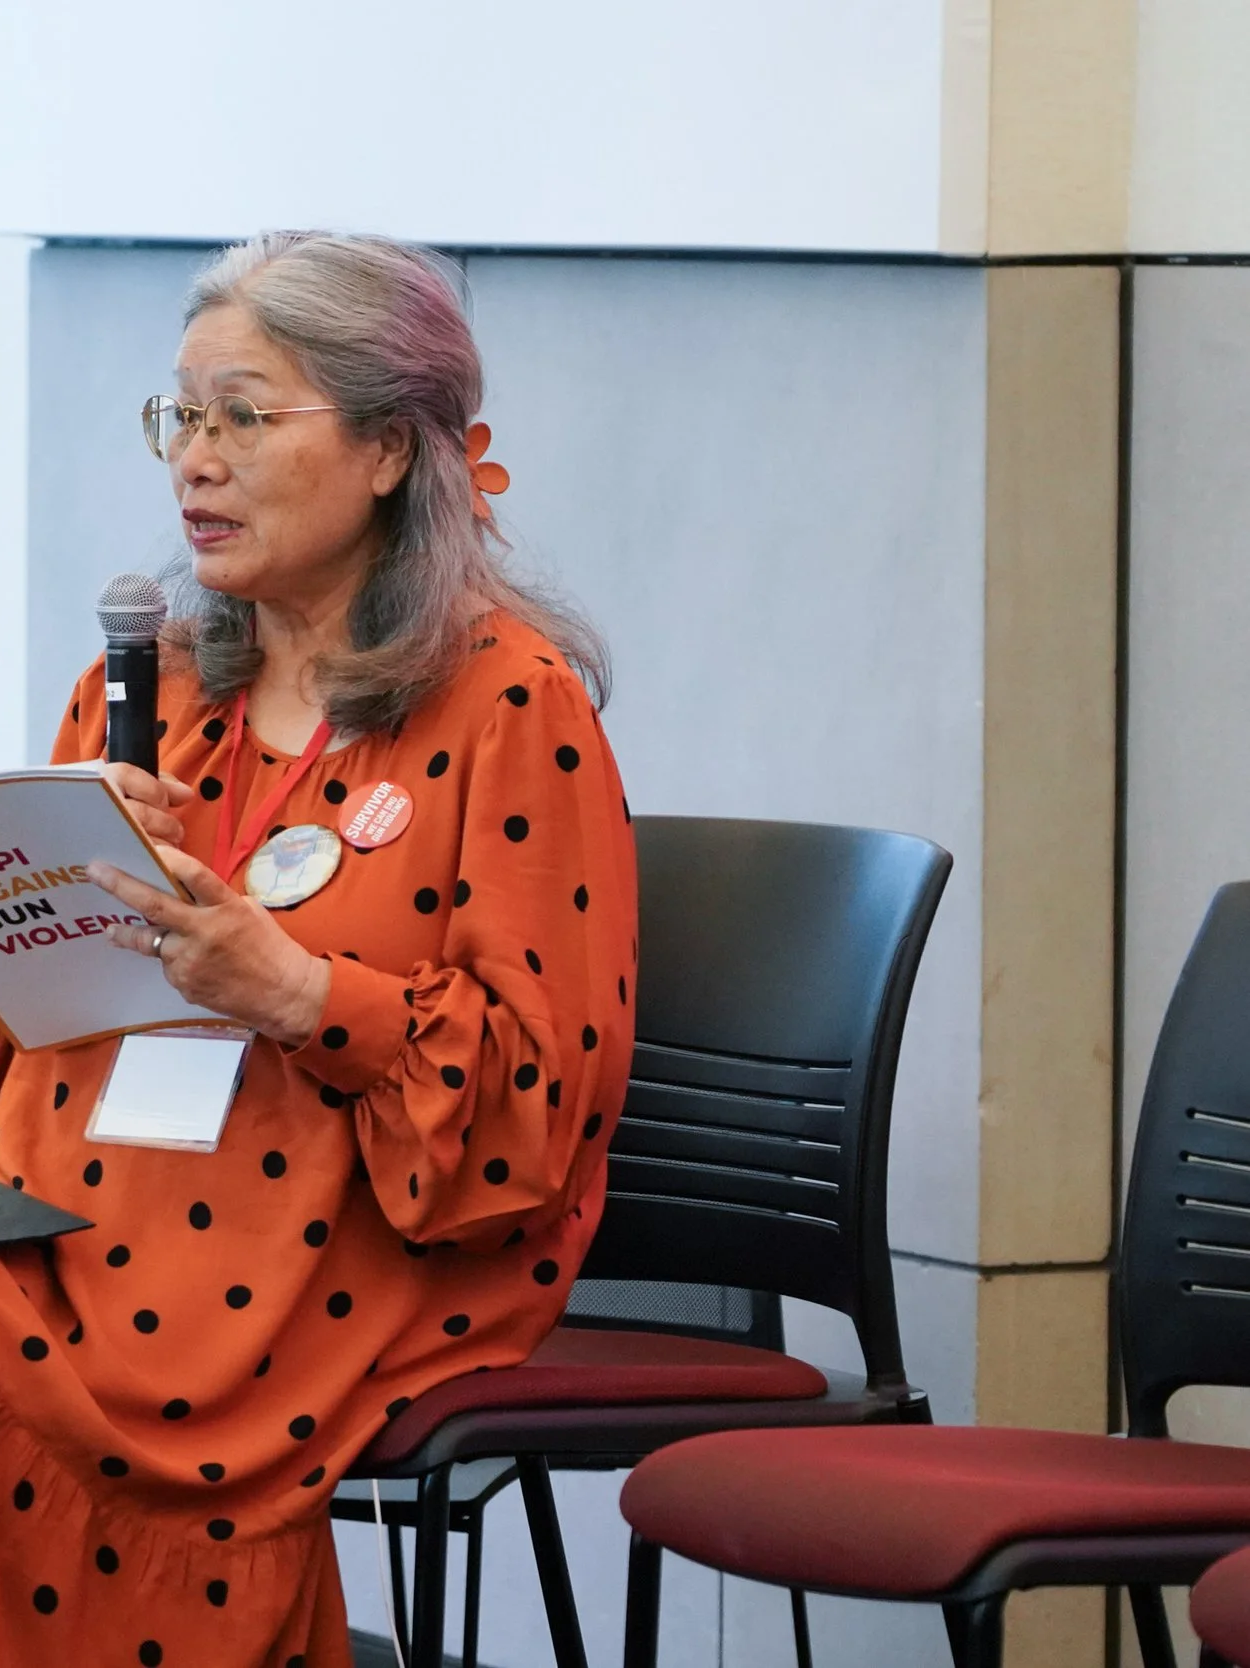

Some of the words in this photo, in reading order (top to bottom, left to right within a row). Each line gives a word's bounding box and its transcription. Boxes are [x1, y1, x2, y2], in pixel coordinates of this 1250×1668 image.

[345, 781, 394, 839] SURVIVOR
[365, 822, 378, 835] WE
[373, 808, 388, 825] CAN
[383, 795, 398, 811] END
